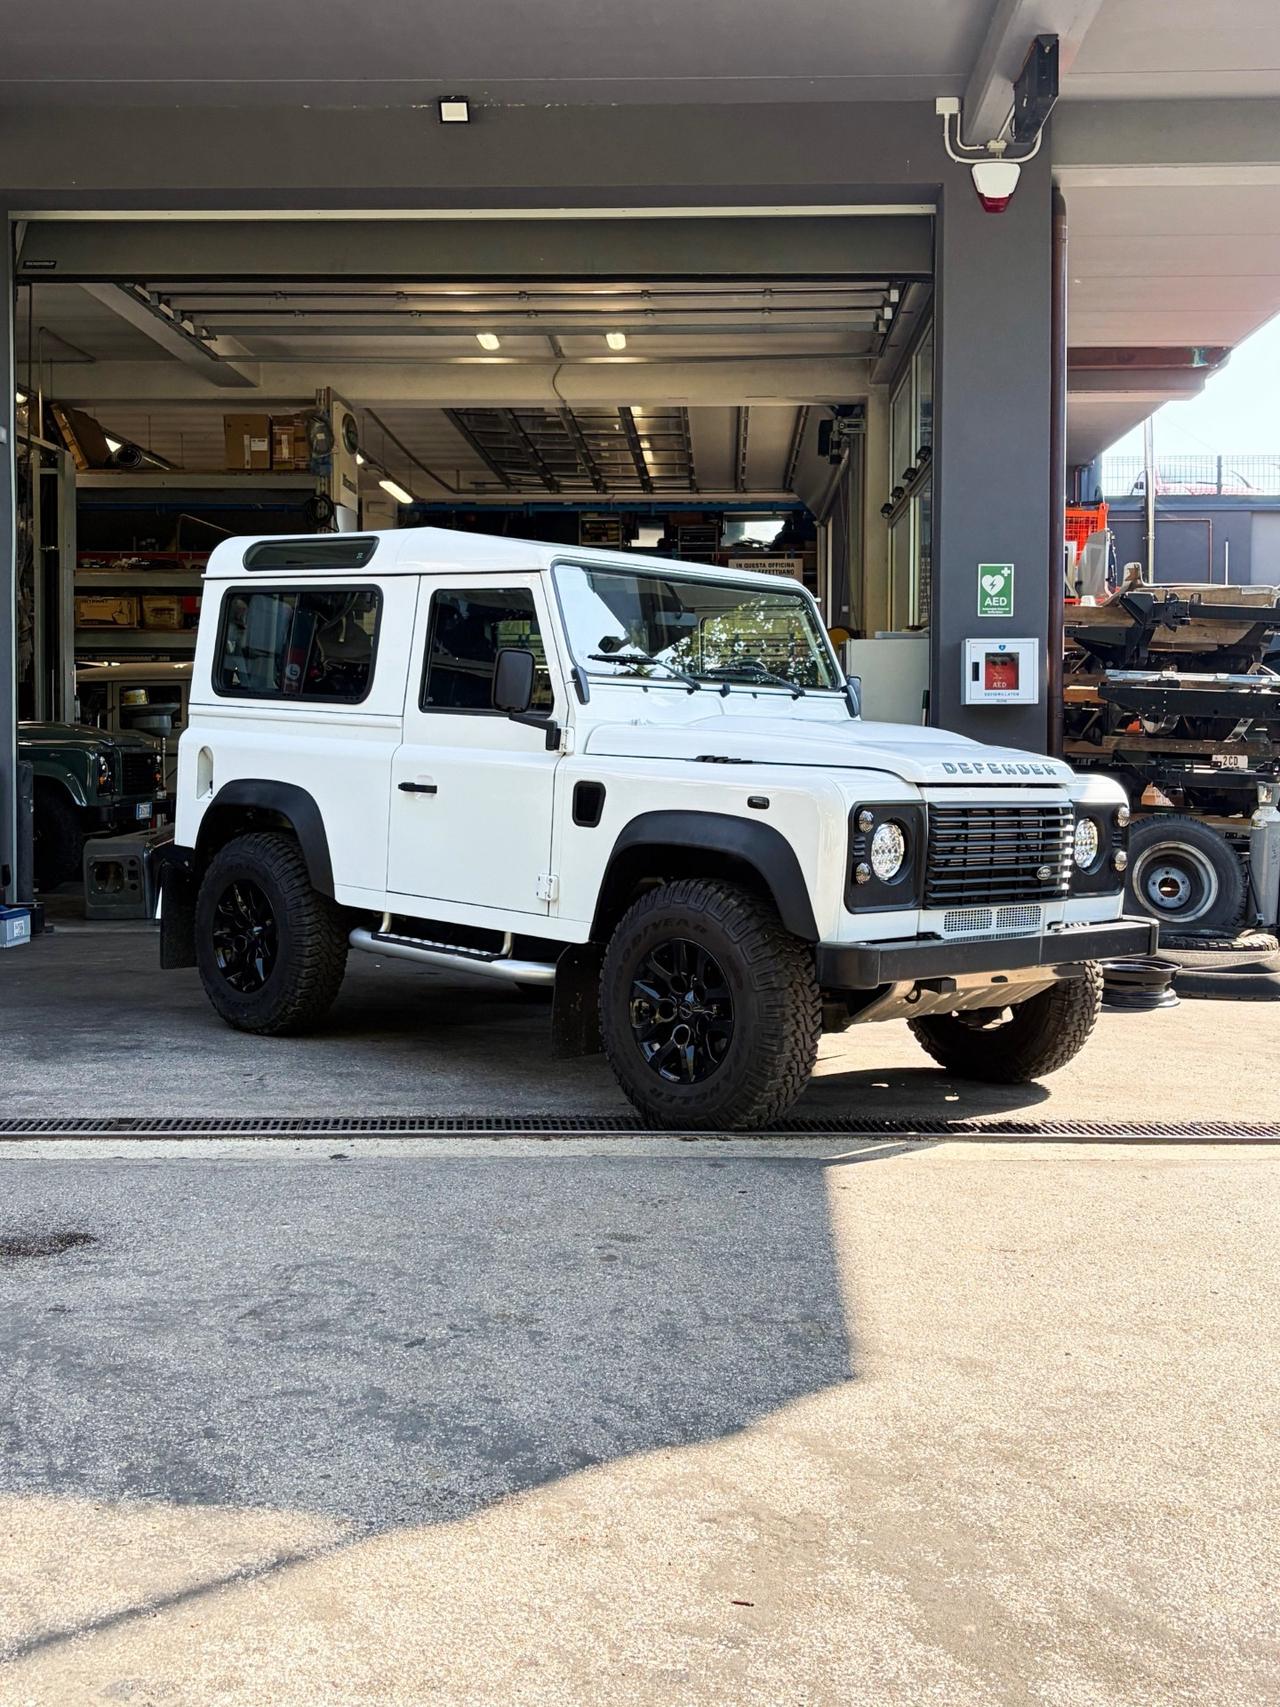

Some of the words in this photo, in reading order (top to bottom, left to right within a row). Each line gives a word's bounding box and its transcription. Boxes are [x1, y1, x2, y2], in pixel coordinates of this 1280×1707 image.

[984, 597, 1008, 606] AED
[992, 681, 1007, 689] AED
[941, 762, 1057, 776] DEFENDER
